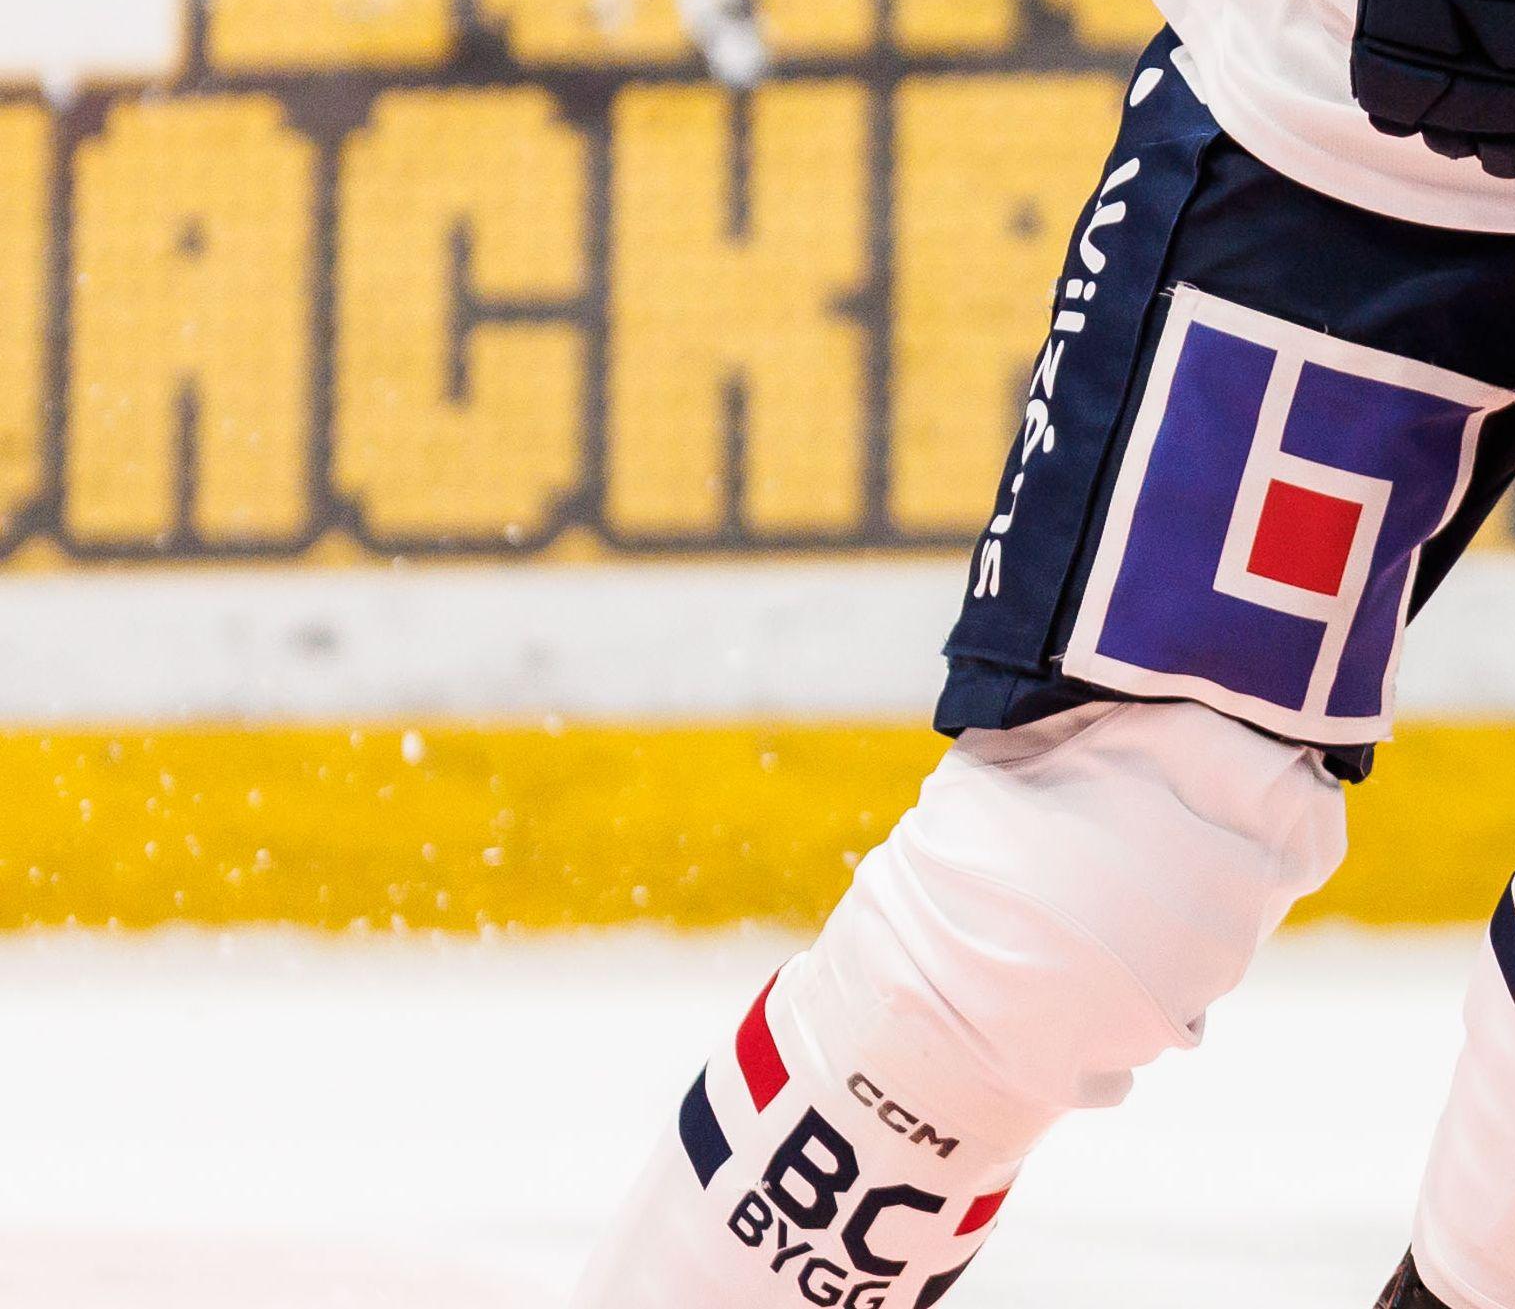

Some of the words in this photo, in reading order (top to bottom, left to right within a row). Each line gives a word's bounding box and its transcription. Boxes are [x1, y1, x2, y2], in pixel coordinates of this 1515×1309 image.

[846, 1071, 960, 1160] CCM
[726, 1190, 892, 1309] BYGG
[761, 1104, 948, 1278] BC
